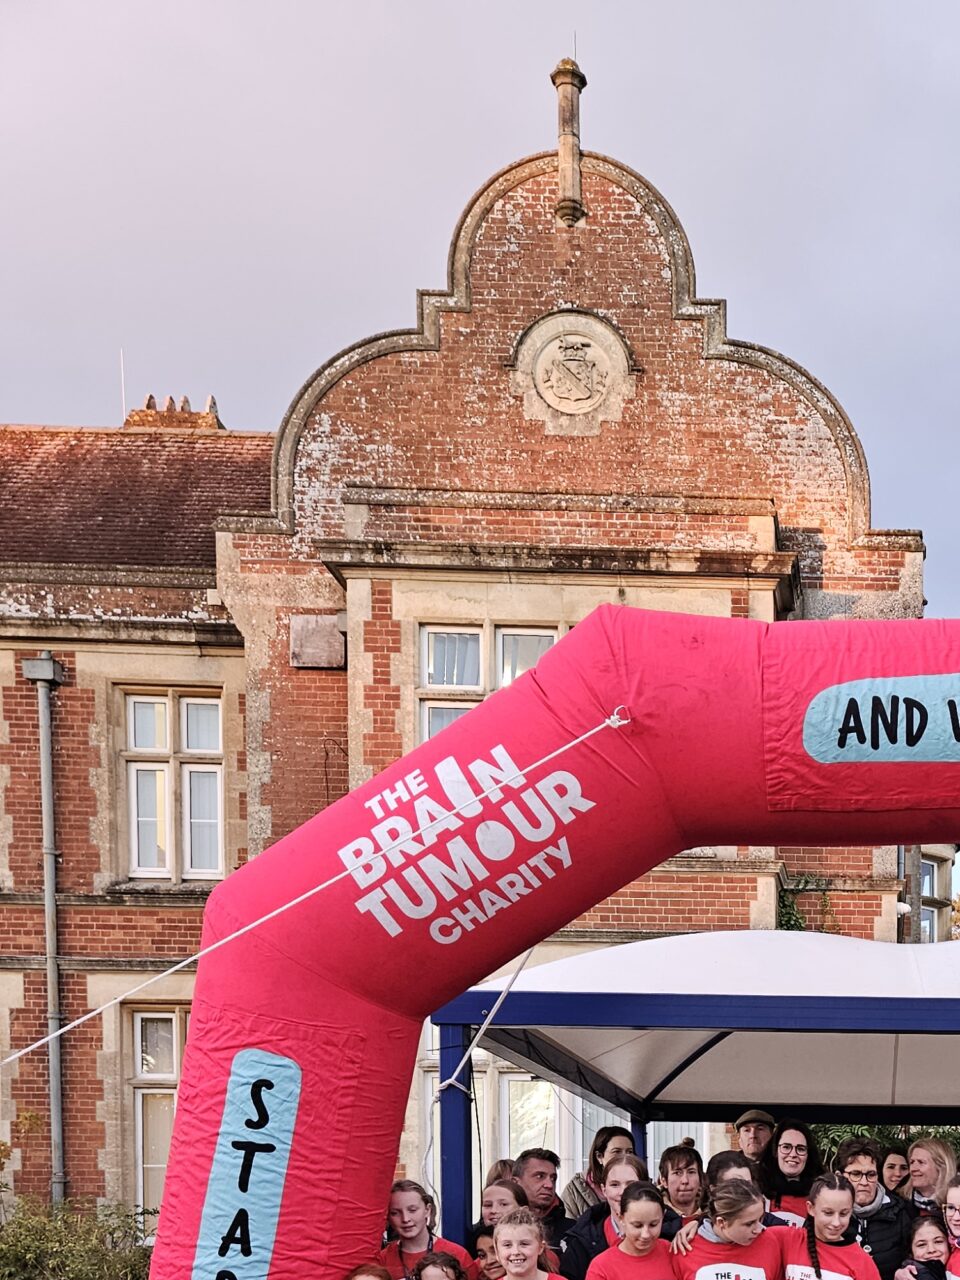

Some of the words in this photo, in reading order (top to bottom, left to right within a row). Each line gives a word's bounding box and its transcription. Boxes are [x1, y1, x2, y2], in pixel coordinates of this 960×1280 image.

[837, 695, 928, 750] AND
[337, 743, 527, 890] BRAIN
[364, 768, 428, 820] THE
[355, 770, 597, 939] TUMOUR
[428, 836, 573, 945] CHARITY
[715, 1272, 732, 1280] THE
